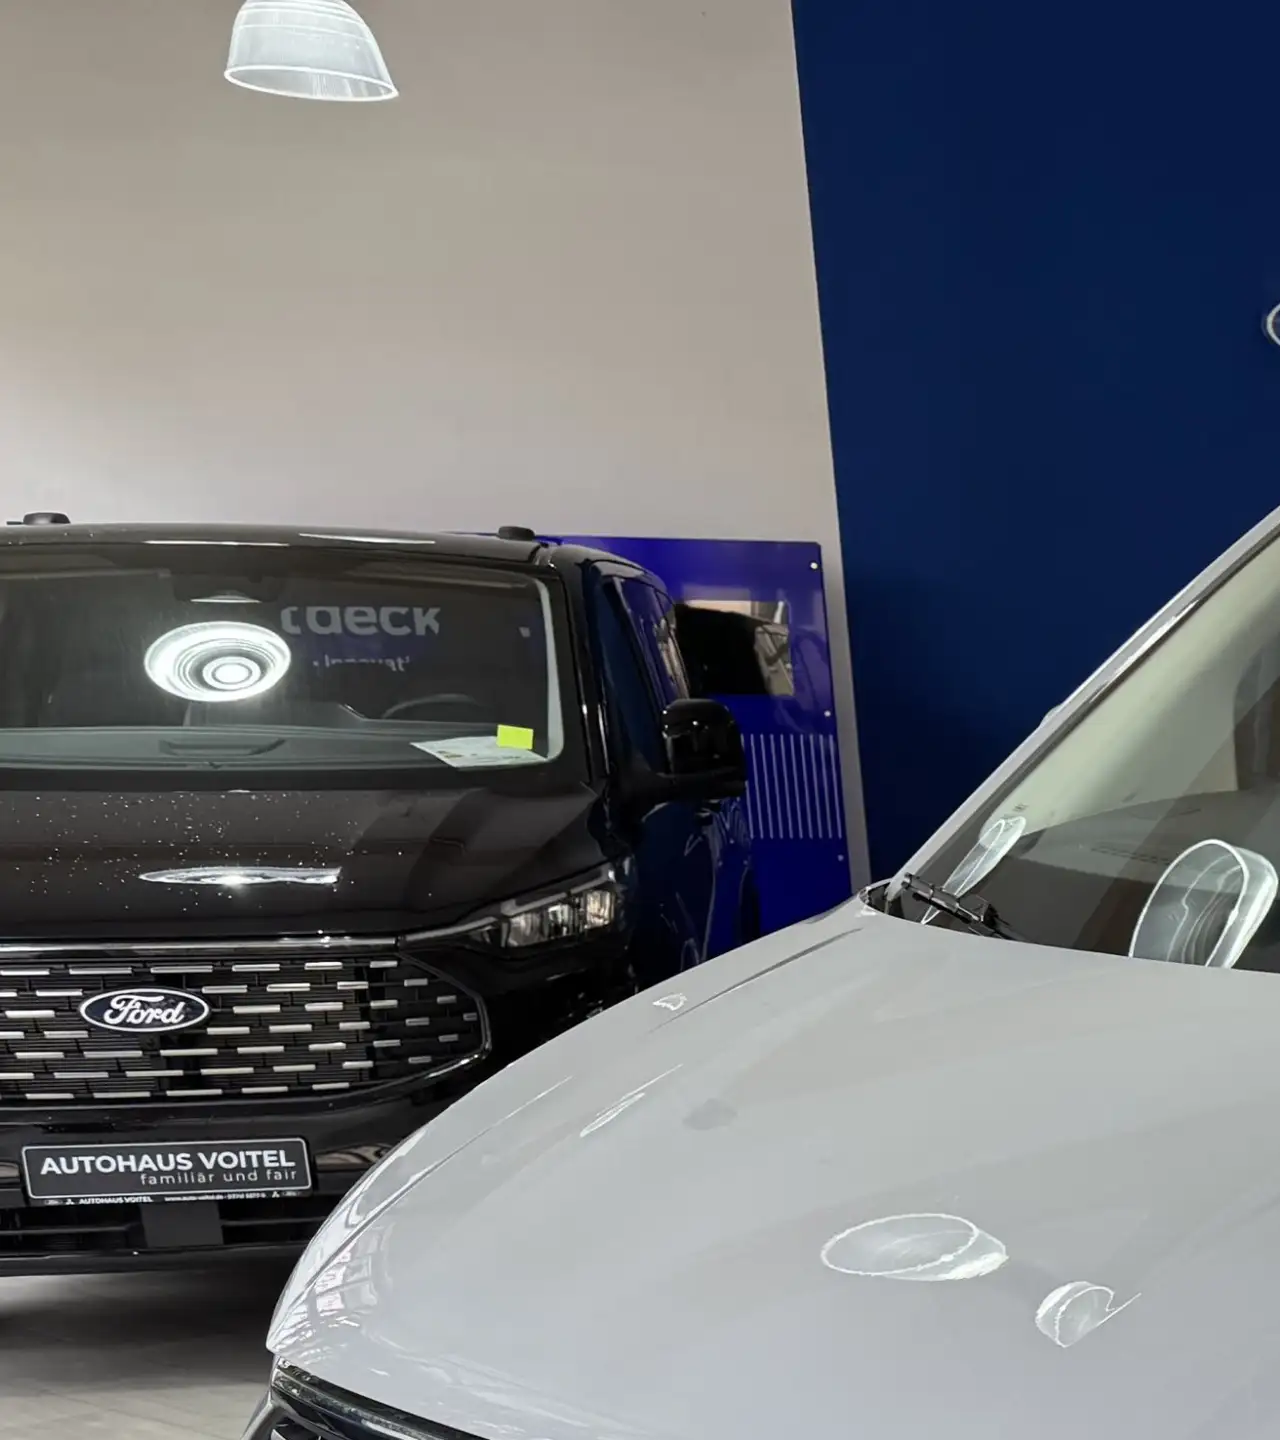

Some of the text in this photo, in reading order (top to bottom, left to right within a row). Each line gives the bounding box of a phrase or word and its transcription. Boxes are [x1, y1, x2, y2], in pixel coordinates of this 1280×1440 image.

[103, 994, 186, 1024] Ford
[40, 1149, 296, 1175] AUTOHAUS VOITEL
[140, 1168, 297, 1187] familiär und fair
